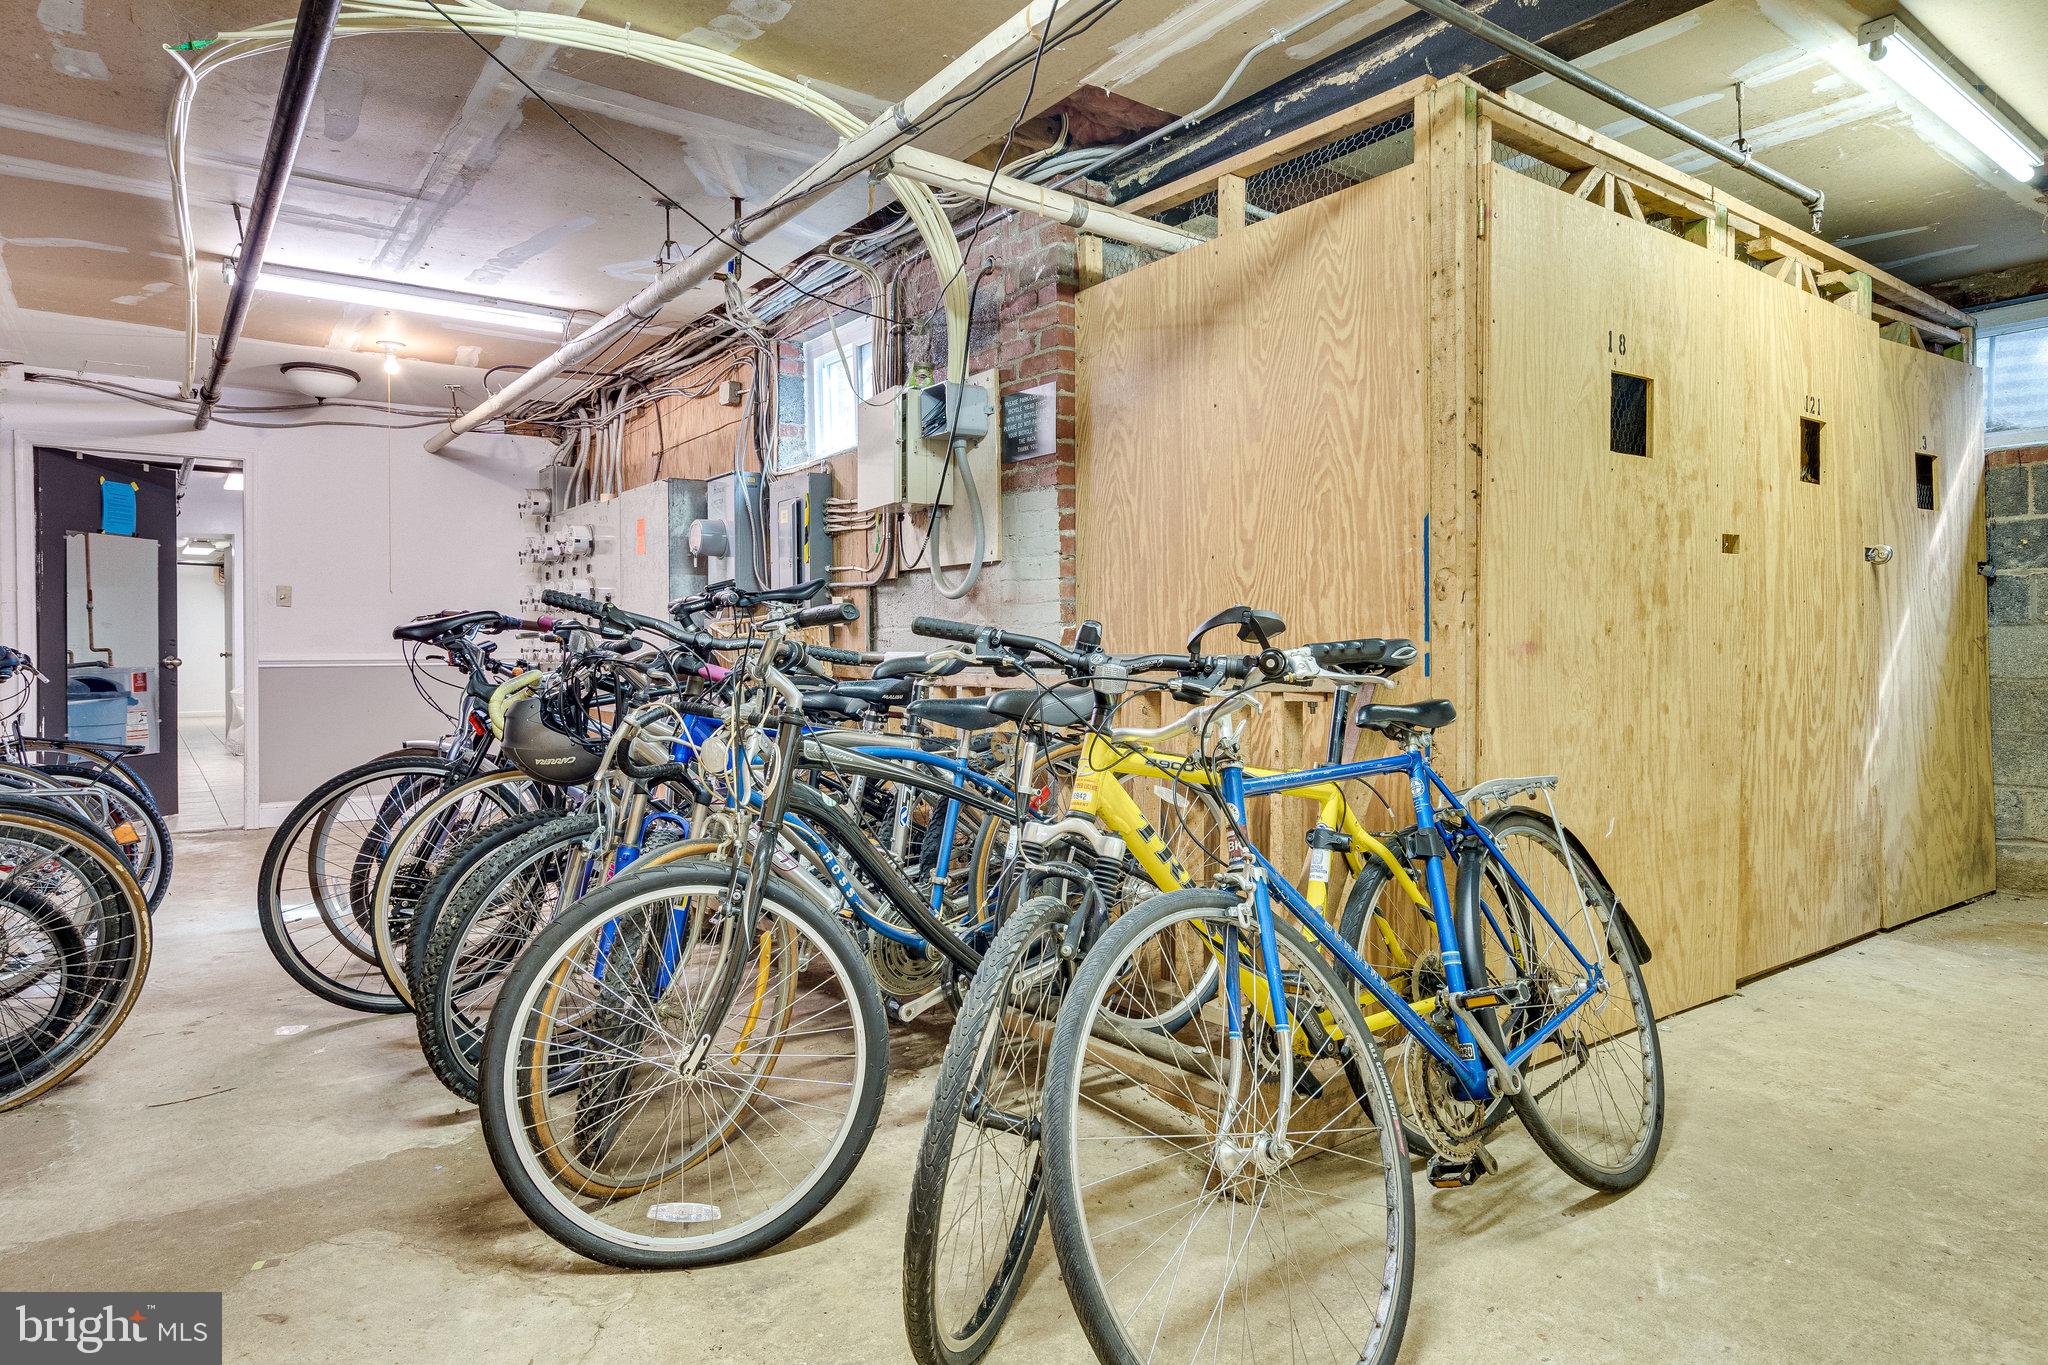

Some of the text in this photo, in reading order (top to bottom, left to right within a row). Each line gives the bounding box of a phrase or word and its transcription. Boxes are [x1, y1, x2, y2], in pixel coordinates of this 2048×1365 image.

[1608, 330, 1626, 356] 18
[1005, 399, 1019, 408] PLEASE
[1805, 395, 1820, 415] 121
[1008, 406, 1022, 414] BICYCLE
[1023, 410, 1038, 419] BICYCLE
[1003, 424, 1017, 432] PLEASE
[1008, 428, 1033, 439] YOUR BICYCLE
[1034, 642, 1069, 662] BONTRAGER
[535, 756, 577, 766] CARRERA
[822, 852, 856, 898] ROSS
[1367, 1042, 1378, 1060] ALL
